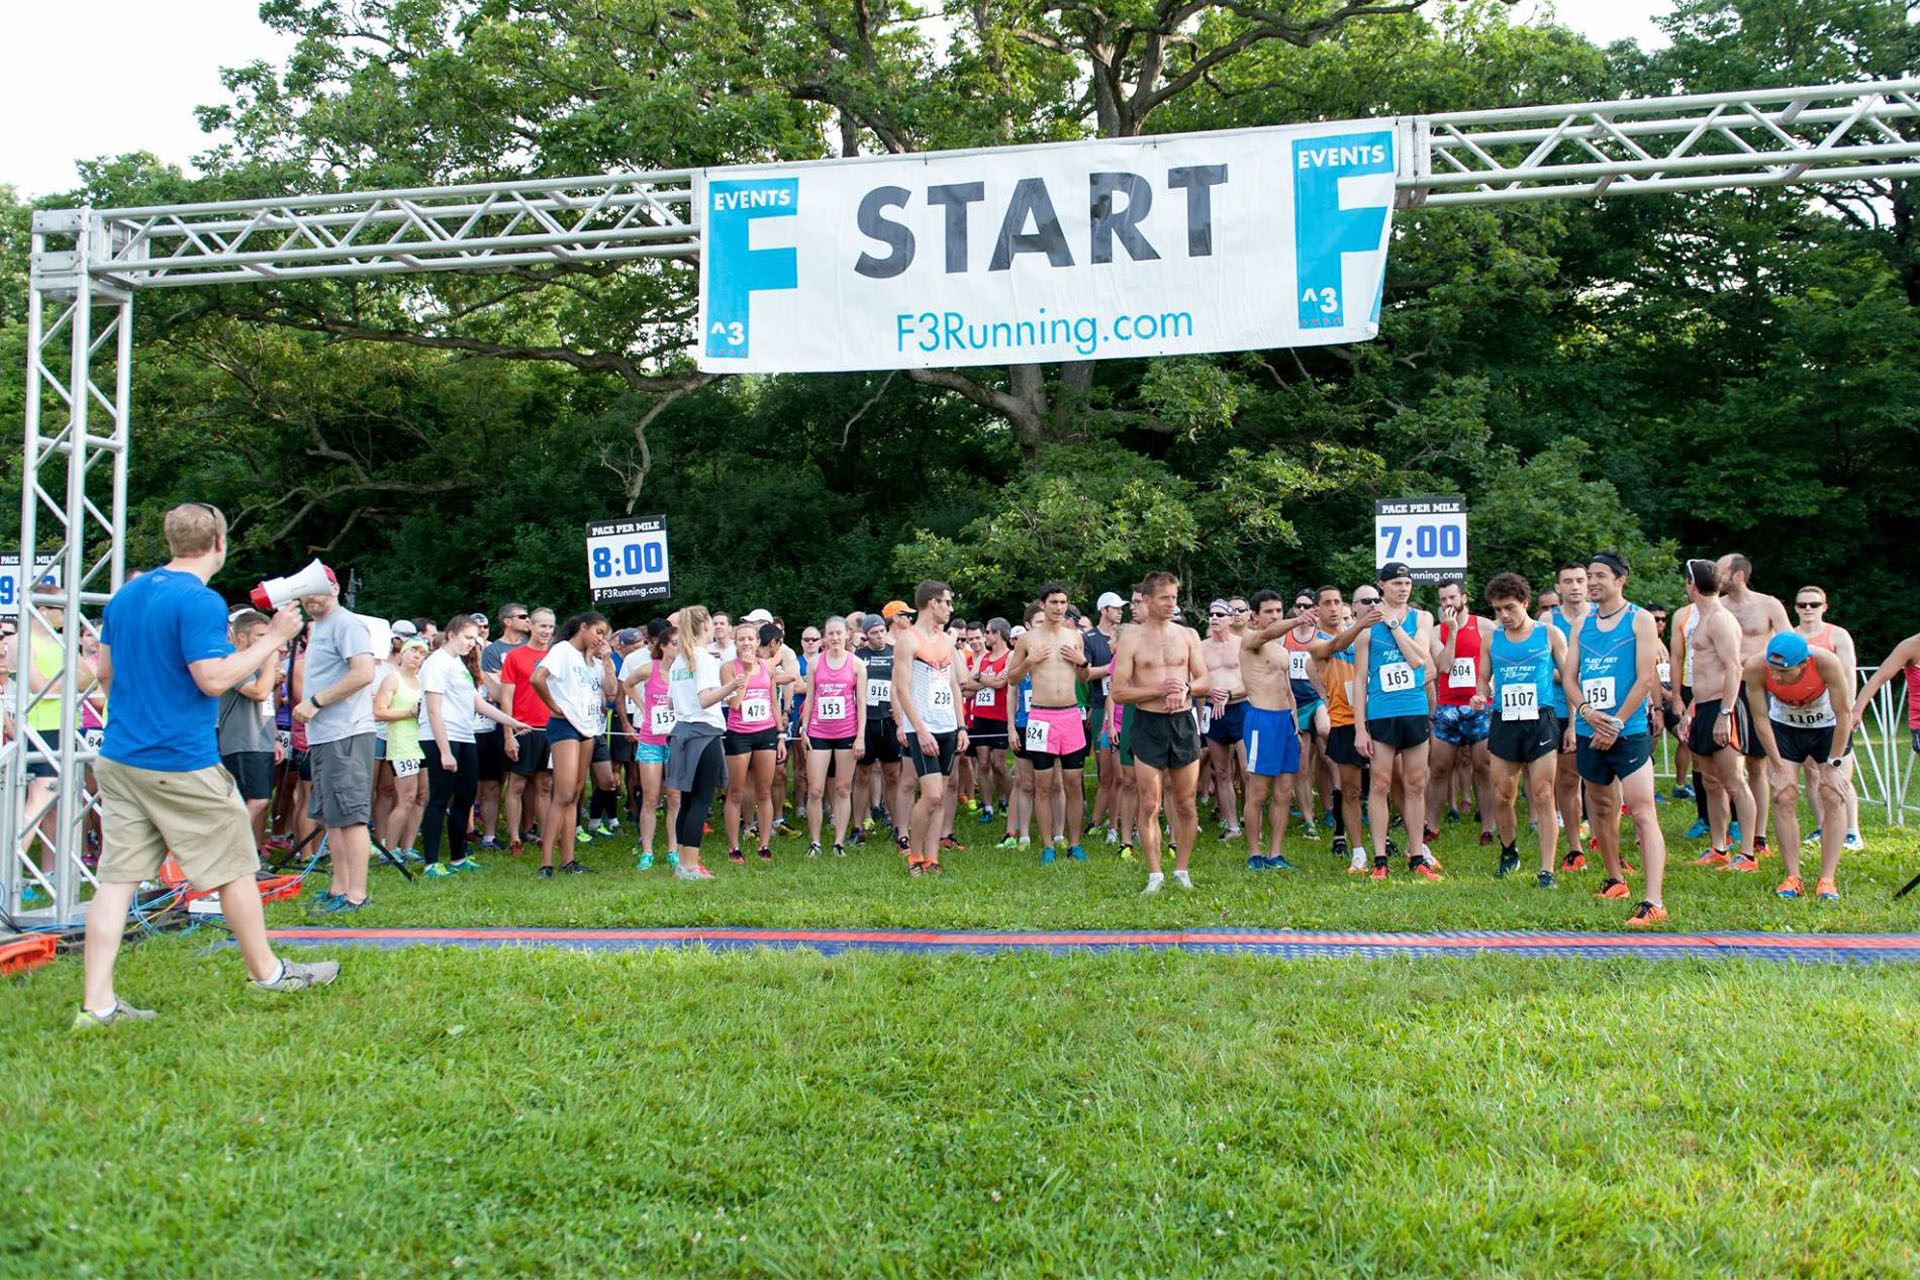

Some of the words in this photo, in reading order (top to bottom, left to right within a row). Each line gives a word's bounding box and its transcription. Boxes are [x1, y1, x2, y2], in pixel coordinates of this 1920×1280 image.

[1299, 145, 1385, 169] EVENTS
[713, 189, 791, 211] EVENTS
[854, 163, 1229, 279] START
[897, 307, 1193, 355] F3Running.com
[1382, 504, 1408, 514] PACE
[1409, 503, 1431, 513] PER
[1432, 502, 1460, 512] MILE
[591, 525, 615, 536] PACE
[616, 523, 635, 534] PER
[636, 521, 660, 532] MILE
[1381, 525, 1460, 558] 7:00
[1, 556, 19, 564] PACE
[593, 542, 663, 578] 8:00
[603, 586, 667, 598] F3Running.com
[1387, 670, 1409, 686] 165
[1452, 665, 1471, 676] 604
[871, 685, 888, 697] 916
[1587, 687, 1607, 703] 159
[1504, 692, 1534, 707] 1107
[823, 703, 840, 715] 153
[656, 712, 675, 724] 155
